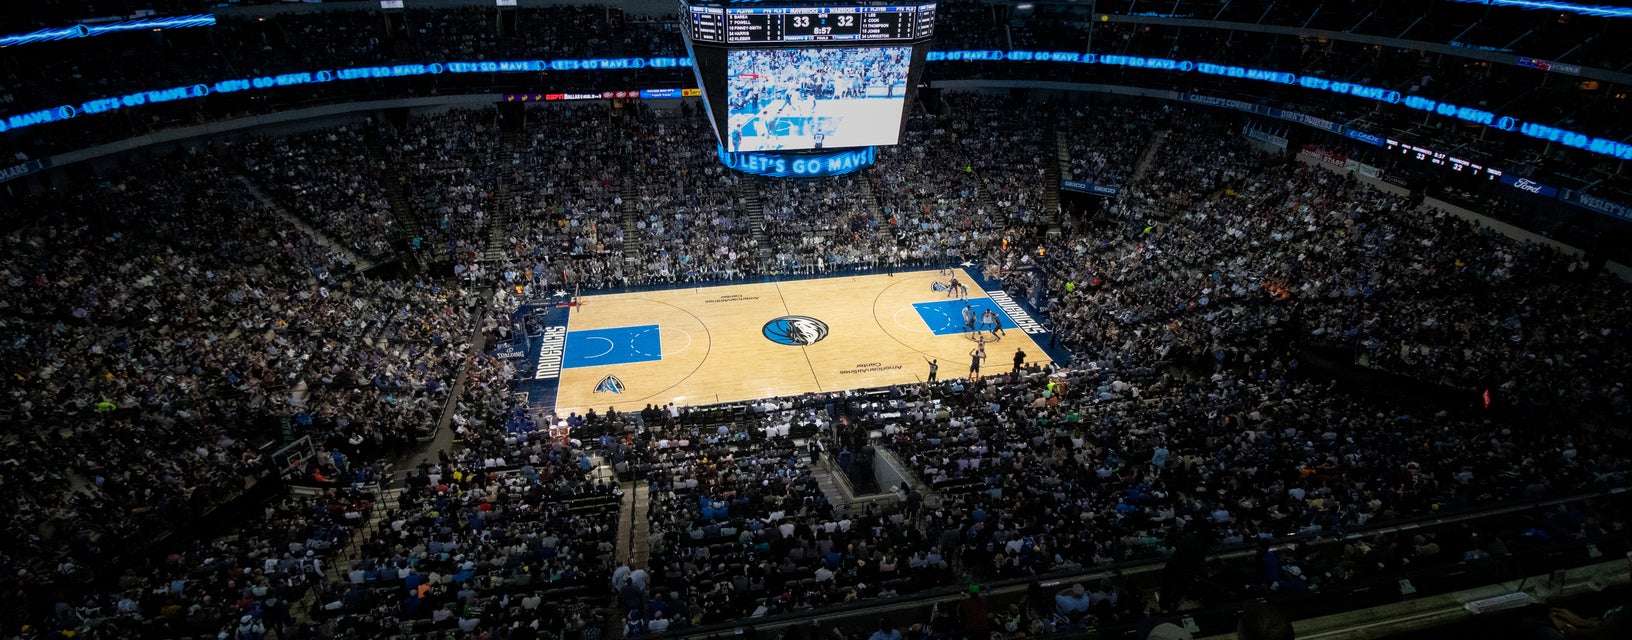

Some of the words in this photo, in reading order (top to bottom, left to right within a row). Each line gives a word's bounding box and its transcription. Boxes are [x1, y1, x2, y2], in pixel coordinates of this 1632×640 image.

[793, 16, 810, 28] 33
[837, 16, 854, 27] 32
[650, 58, 676, 67] LET'S
[926, 52, 945, 61] ET'S
[947, 52, 960, 60] GO
[963, 52, 987, 60] MAVS
[1008, 52, 1032, 60] LET'S
[1035, 52, 1049, 60] GO
[1052, 53, 1078, 61] MAVS
[1100, 55, 1125, 64] LET'S
[1129, 57, 1144, 66] GO
[1148, 58, 1176, 69] MAVS
[337, 68, 371, 80] LET'S
[372, 66, 390, 78] GO
[393, 64, 424, 76] MAVS
[448, 62, 477, 72] LET'S
[480, 62, 497, 72] GO
[500, 61, 528, 71] MAVS
[552, 60, 579, 70] LET'S
[582, 60, 597, 69] GO
[600, 59, 627, 68] MAVS
[1198, 63, 1225, 75] LET'S
[1228, 66, 1245, 77] GO
[1248, 69, 1277, 82] MAVS
[215, 79, 249, 93] LET'S
[253, 77, 273, 88] GO
[276, 72, 311, 86] MAVS
[1301, 76, 1329, 90] LET'S
[1331, 82, 1349, 93] GO
[1351, 84, 1384, 99] MAVS
[123, 92, 145, 106] GO
[149, 87, 186, 102] MAVS
[1226, 99, 1252, 109] CORNER
[1281, 110, 1304, 122] DIRK'S
[1405, 96, 1436, 111] LET'S
[1437, 102, 1456, 117] GO
[1458, 107, 1494, 125] MAVS
[10, 110, 52, 128] MAVS
[1521, 122, 1560, 141] LET'S
[1563, 132, 1587, 147] GO
[1590, 138, 1632, 159] MAVS
[741, 154, 785, 172] LET'S
[793, 158, 820, 174] GO
[828, 150, 866, 172] MAVS
[1453, 163, 1463, 171] 32
[1514, 178, 1542, 193] Ford
[1580, 195, 1626, 216] WESLEY'S
[987, 290, 1046, 334] MAVERICKS
[497, 351, 524, 359] SPALDING
[535, 326, 566, 379] MAVERICKS
